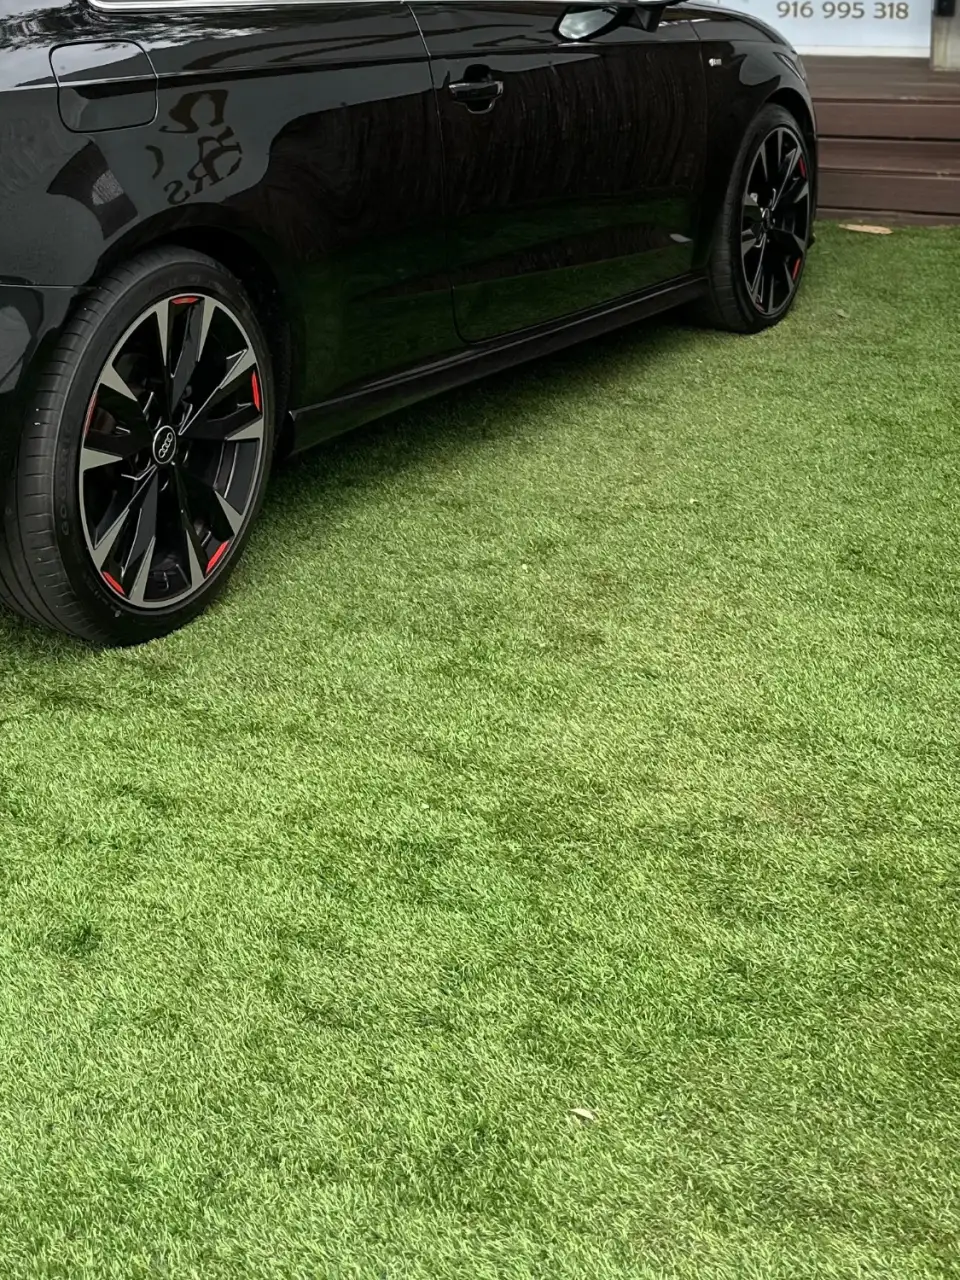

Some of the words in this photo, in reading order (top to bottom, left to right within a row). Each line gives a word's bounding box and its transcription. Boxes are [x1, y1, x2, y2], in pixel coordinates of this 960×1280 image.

[776, 0, 815, 19] 916
[821, 0, 866, 20] 995
[872, 1, 910, 20] 318
